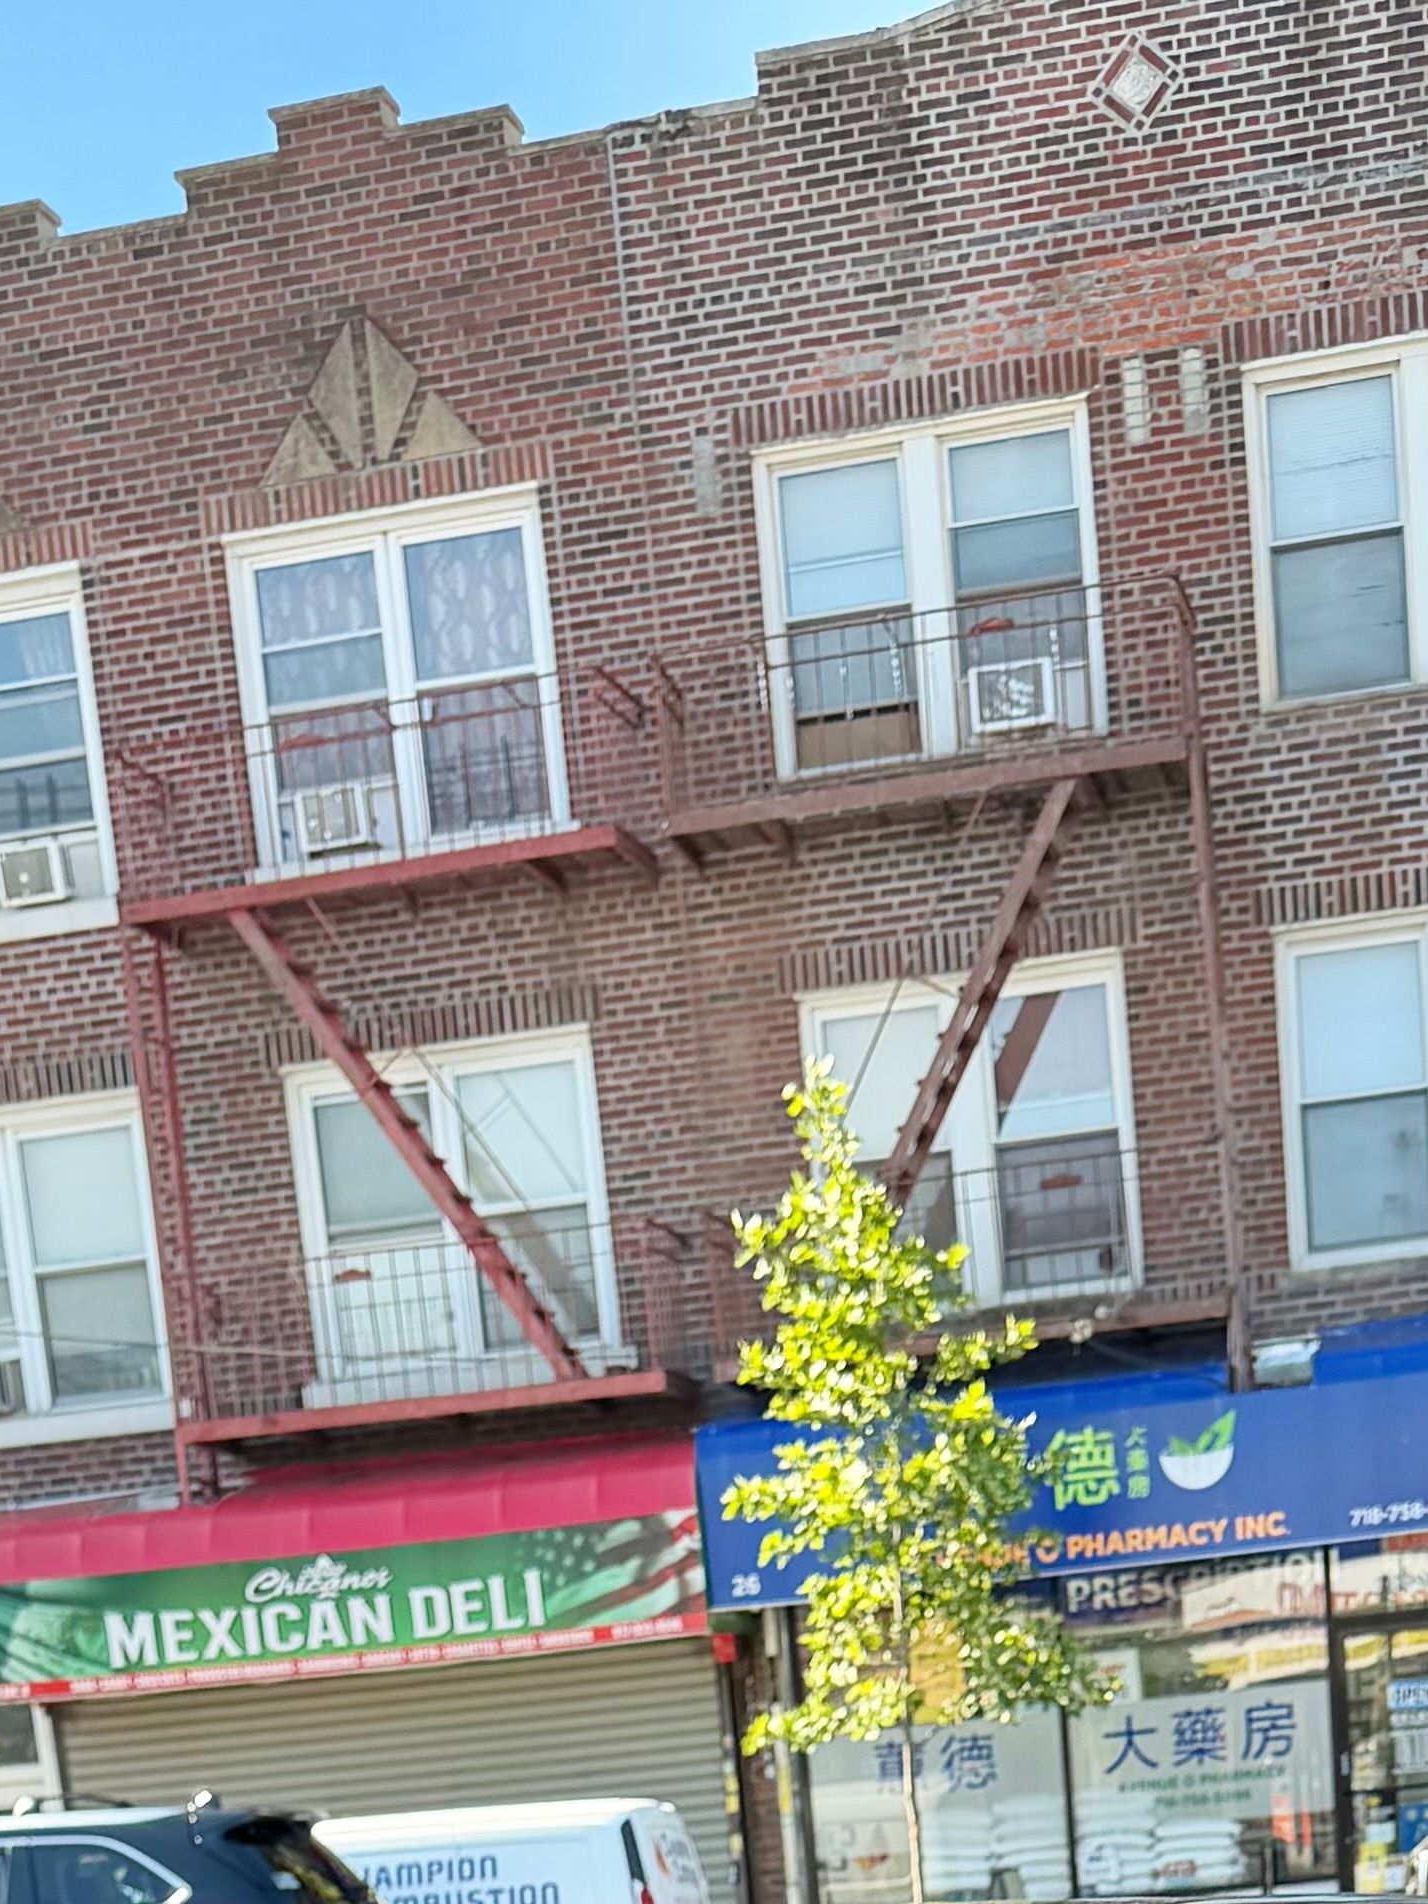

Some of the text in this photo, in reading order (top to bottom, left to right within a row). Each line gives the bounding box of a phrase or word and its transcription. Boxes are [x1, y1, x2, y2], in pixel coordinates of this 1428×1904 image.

[1065, 1516, 1228, 1561] PHARMACY
[103, 1592, 396, 1672] MEXICAN
[408, 1568, 548, 1641] DELI
[363, 1854, 498, 1892] AMPION
